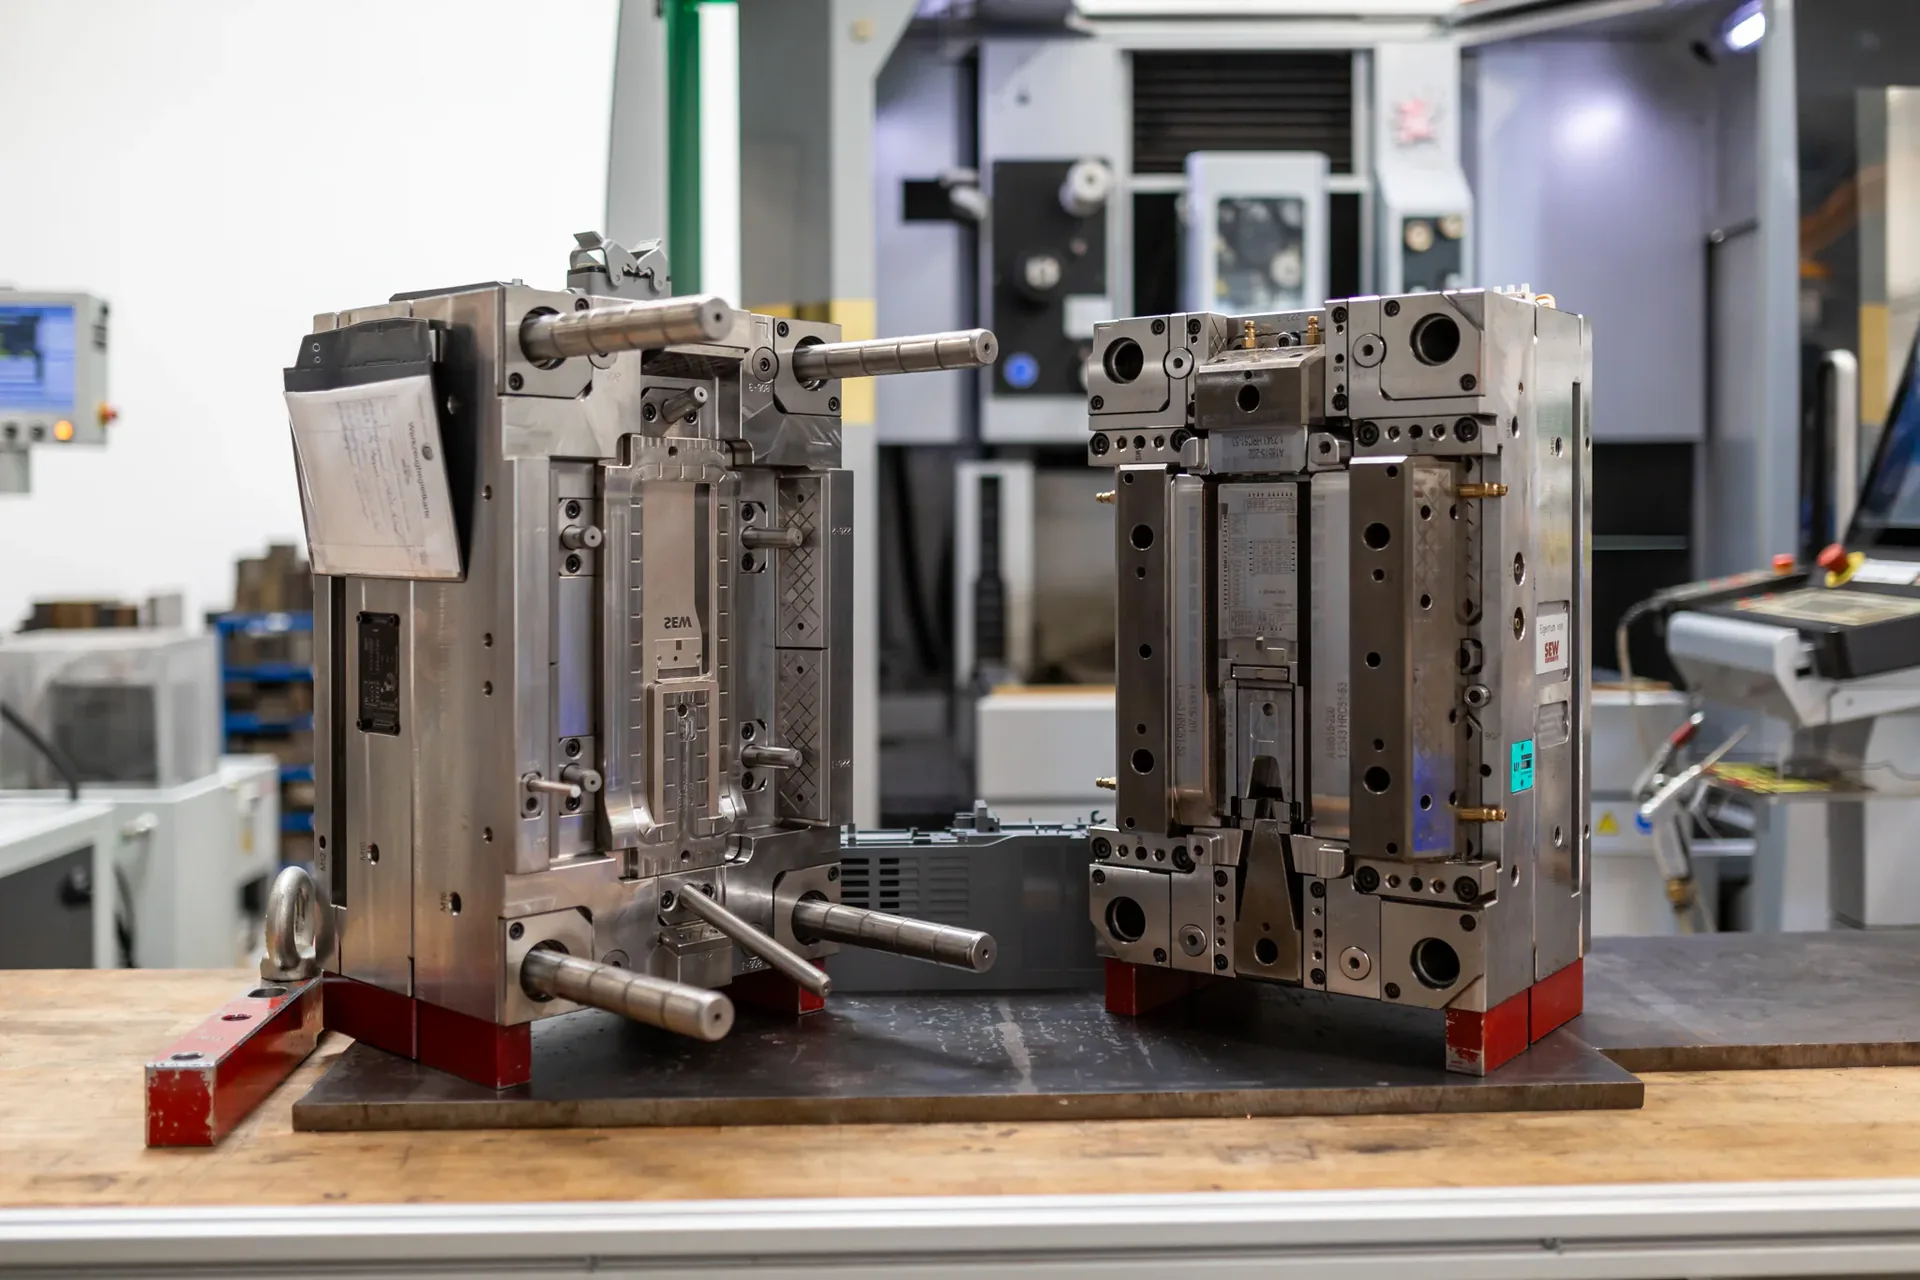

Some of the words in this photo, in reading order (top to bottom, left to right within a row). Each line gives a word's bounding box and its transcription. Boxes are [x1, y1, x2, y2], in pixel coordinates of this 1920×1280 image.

[408, 421, 430, 519] Werkzeugbegleitkarte
[1544, 640, 1560, 658] SEW
[1337, 681, 1348, 728] HRC51-53
